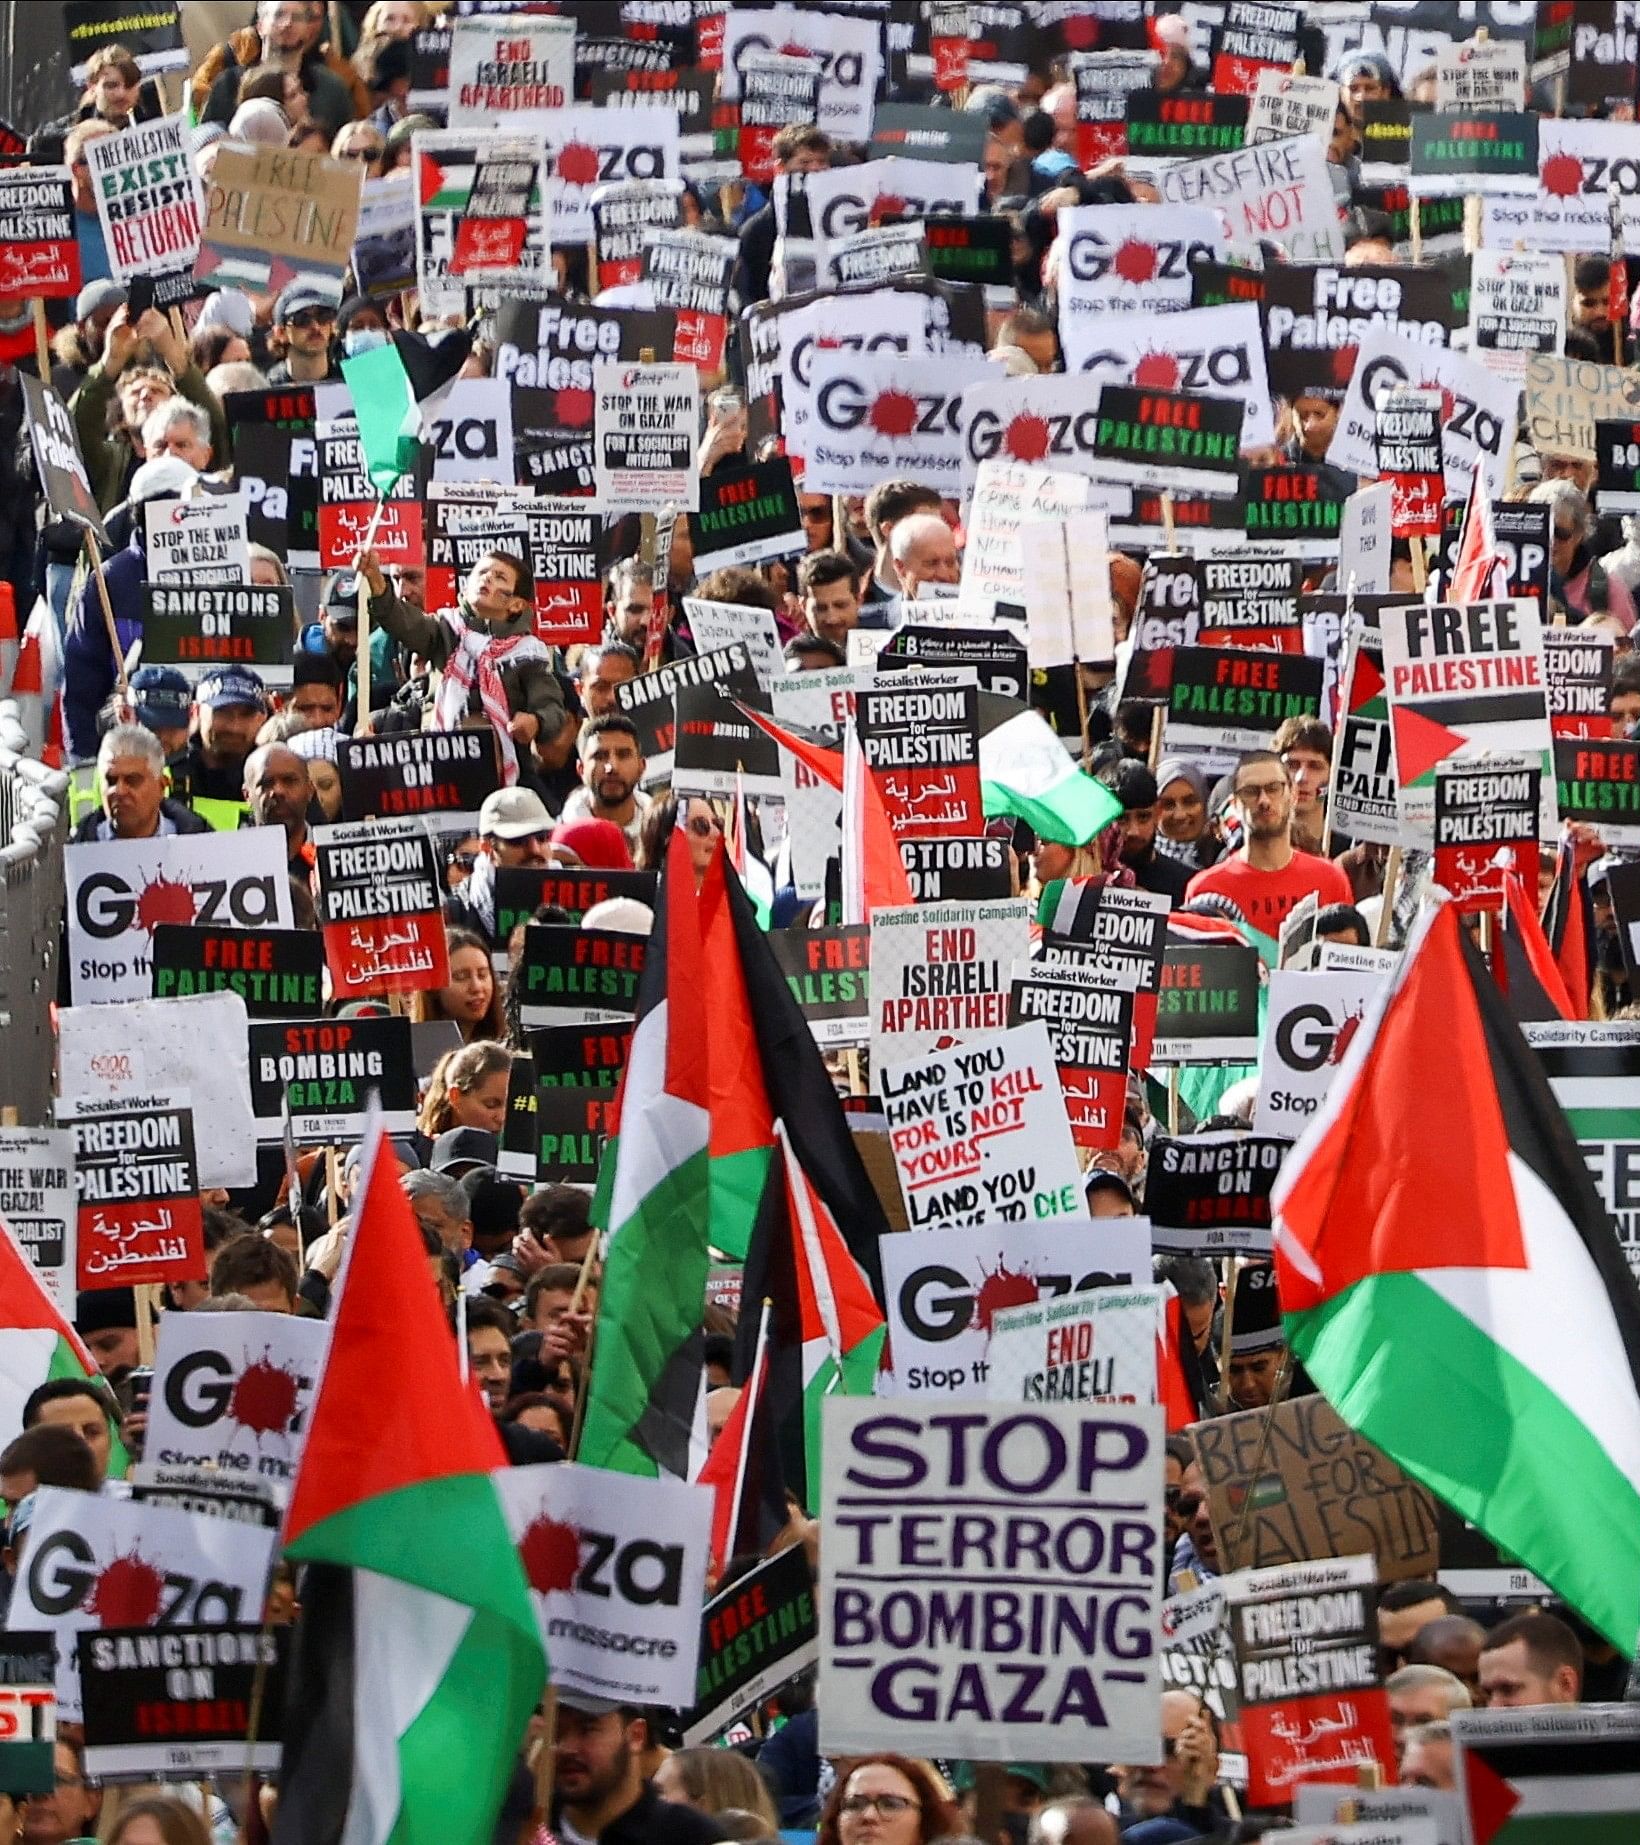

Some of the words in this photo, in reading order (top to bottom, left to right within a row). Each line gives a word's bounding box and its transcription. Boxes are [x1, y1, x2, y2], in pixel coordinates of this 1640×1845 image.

[94, 143, 126, 168] FREE
[126, 121, 180, 157] PALESTINE
[101, 160, 188, 199] EXIST!
[1164, 143, 1306, 203] CEASFIRE
[107, 180, 193, 222] RESIST!
[1245, 189, 1304, 232] NOT
[112, 201, 200, 267] RETURN!
[1315, 272, 1401, 309] Free
[700, 495, 785, 530] PALESTINE
[153, 530, 183, 547] STOP
[187, 529, 208, 545] THE
[210, 526, 241, 544] WAR
[1205, 561, 1291, 588] FREEDOM
[153, 590, 279, 615] SANCTIONS
[1204, 597, 1299, 626] PALESTINE
[202, 615, 229, 635] ON
[1407, 605, 1521, 656] FREE
[873, 675, 918, 689] Socialist
[921, 672, 959, 686] Worker
[1394, 656, 1539, 694] PALESTINE
[868, 694, 966, 723] FREEDOM
[1174, 683, 1316, 714] PALESTINE
[347, 735, 481, 769] SANCTIONS
[864, 733, 974, 761] PALESTINE
[402, 761, 432, 787] ON
[885, 778, 955, 798] الحرية
[331, 828, 375, 841] Socialist
[377, 823, 416, 836] Worker
[1441, 812, 1533, 842] PALESTINE
[328, 845, 424, 872] FREEDOM
[327, 884, 432, 916] PALESTINE
[873, 910, 920, 926] Palestine
[922, 906, 975, 924] Solidarity
[978, 905, 1027, 921] Campaign
[205, 939, 272, 970] FREE
[350, 925, 418, 951] الحرية
[926, 929, 975, 962] END
[80, 959, 127, 981] Stop
[346, 951, 433, 983] لفلسطين
[903, 962, 998, 995] ISRAELI
[1031, 966, 1076, 982] Socialist
[1079, 972, 1117, 987] Worker
[159, 970, 316, 1003] PALESTINE
[882, 993, 1008, 1032] APARTHEI
[1021, 987, 1119, 1023] FREEDOM
[287, 1028, 351, 1049] STOP
[1529, 1030, 1584, 1043] Solidarity
[261, 1052, 382, 1081] BOMBING
[881, 1060, 947, 1096] LAND
[955, 1047, 1004, 1078] YOU
[75, 1100, 127, 1114] Socialist
[130, 1098, 169, 1111] Worker
[290, 1081, 355, 1105] GAZA
[888, 1096, 950, 1124] HAVE
[955, 1081, 984, 1105] TO
[990, 1069, 1043, 1097] KILL
[74, 1117, 179, 1152] FREEDOM
[893, 1123, 940, 1151] FOR
[948, 1115, 967, 1136] IS
[971, 1101, 1023, 1132] NOT
[29, 1169, 67, 1187] WAR
[73, 1164, 190, 1200] PALESTINE
[1219, 1170, 1250, 1193] ON
[910, 1189, 979, 1224] LAND
[982, 1170, 1035, 1204] YOU
[996, 1201, 1027, 1222] TO
[1034, 1186, 1076, 1218] DIE
[94, 1209, 172, 1234] الحرية
[86, 1238, 187, 1273] لفلسطين
[1047, 1320, 1092, 1369] END
[847, 1414, 1150, 1495] STOP
[1305, 1452, 1389, 1501] FOR
[838, 1516, 1156, 1574] TERROR
[549, 1617, 677, 1658] massacre
[834, 1592, 1153, 1661] BOMBING
[92, 1636, 275, 1670] SANCTIONS
[169, 1669, 214, 1700] ON
[1242, 1648, 1376, 1700] PALESTINE
[871, 1664, 1109, 1726] GAZA
